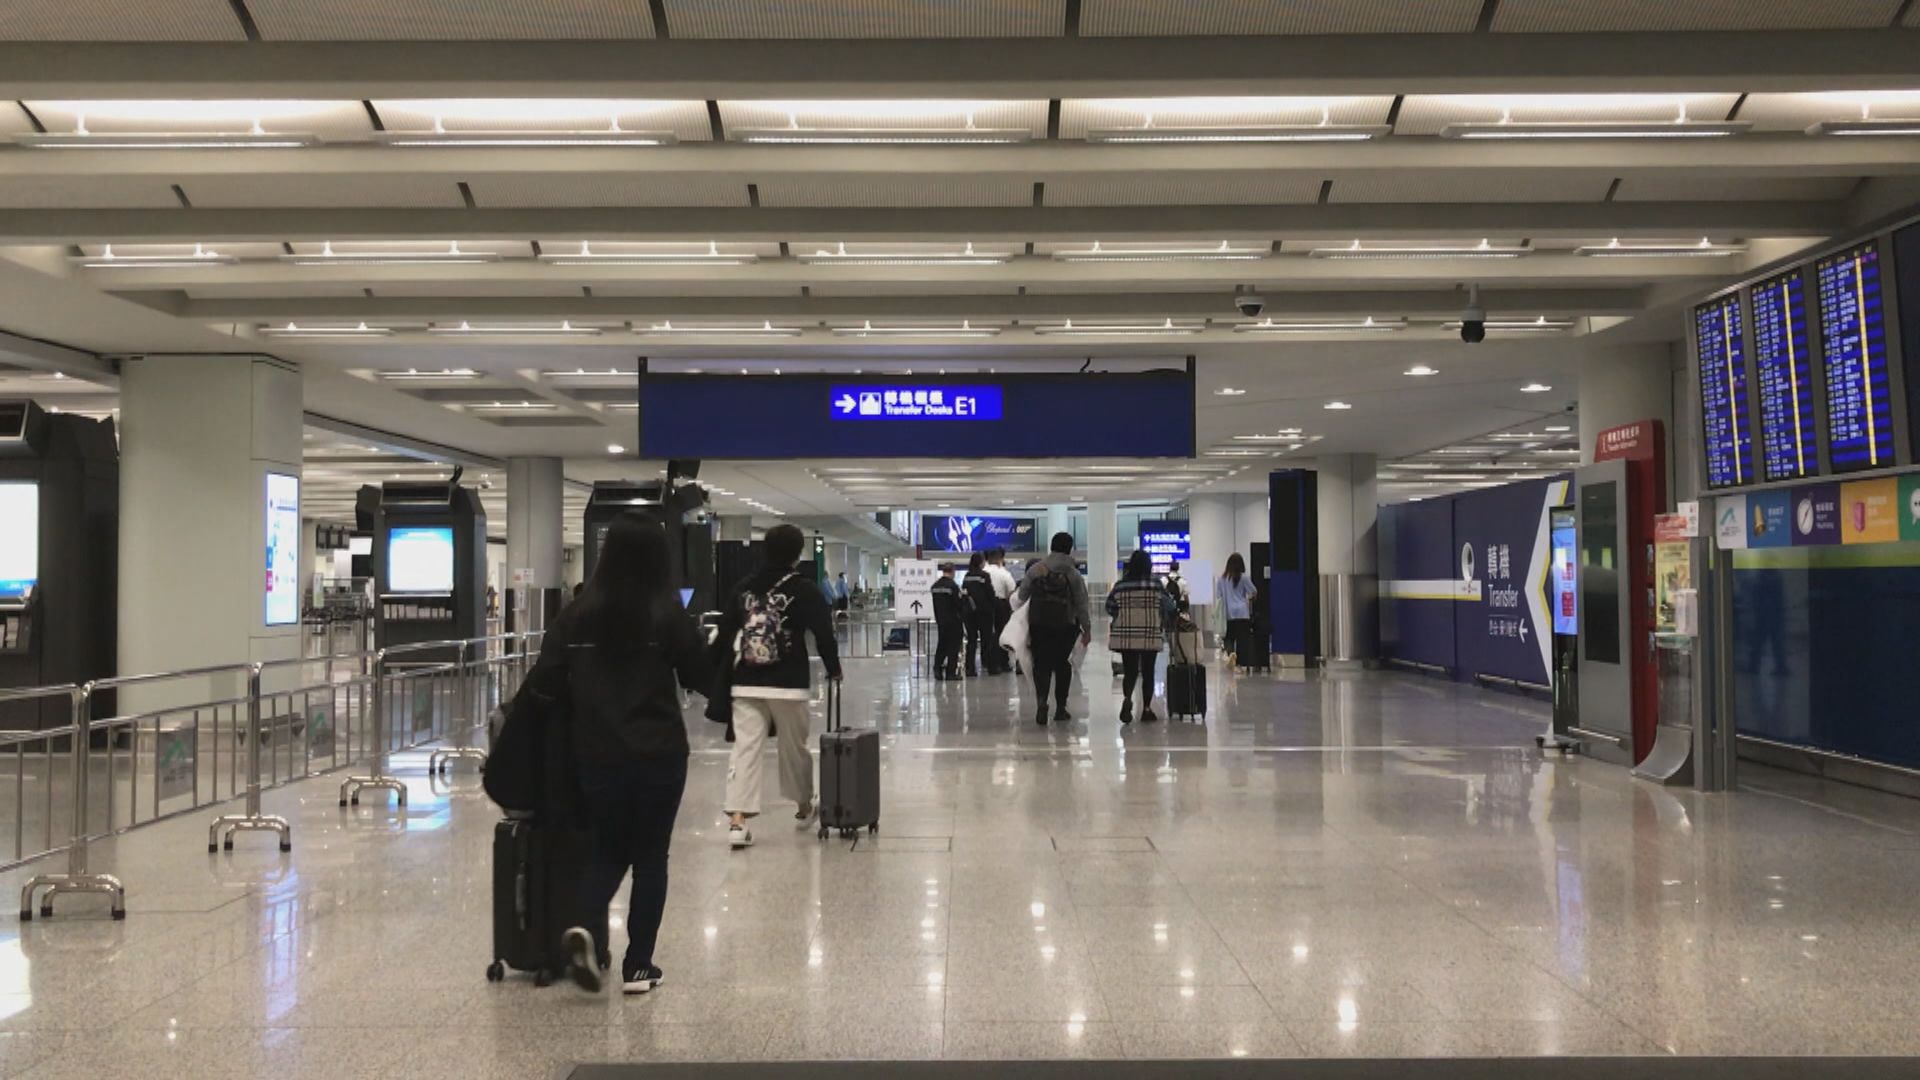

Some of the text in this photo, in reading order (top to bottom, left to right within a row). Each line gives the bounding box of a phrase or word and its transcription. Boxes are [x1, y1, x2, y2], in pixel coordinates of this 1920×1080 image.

[955, 396, 976, 415] E1
[984, 521, 1012, 535] Chopard
[1016, 524, 1032, 534] 007
[1487, 583, 1519, 608] Transfer
